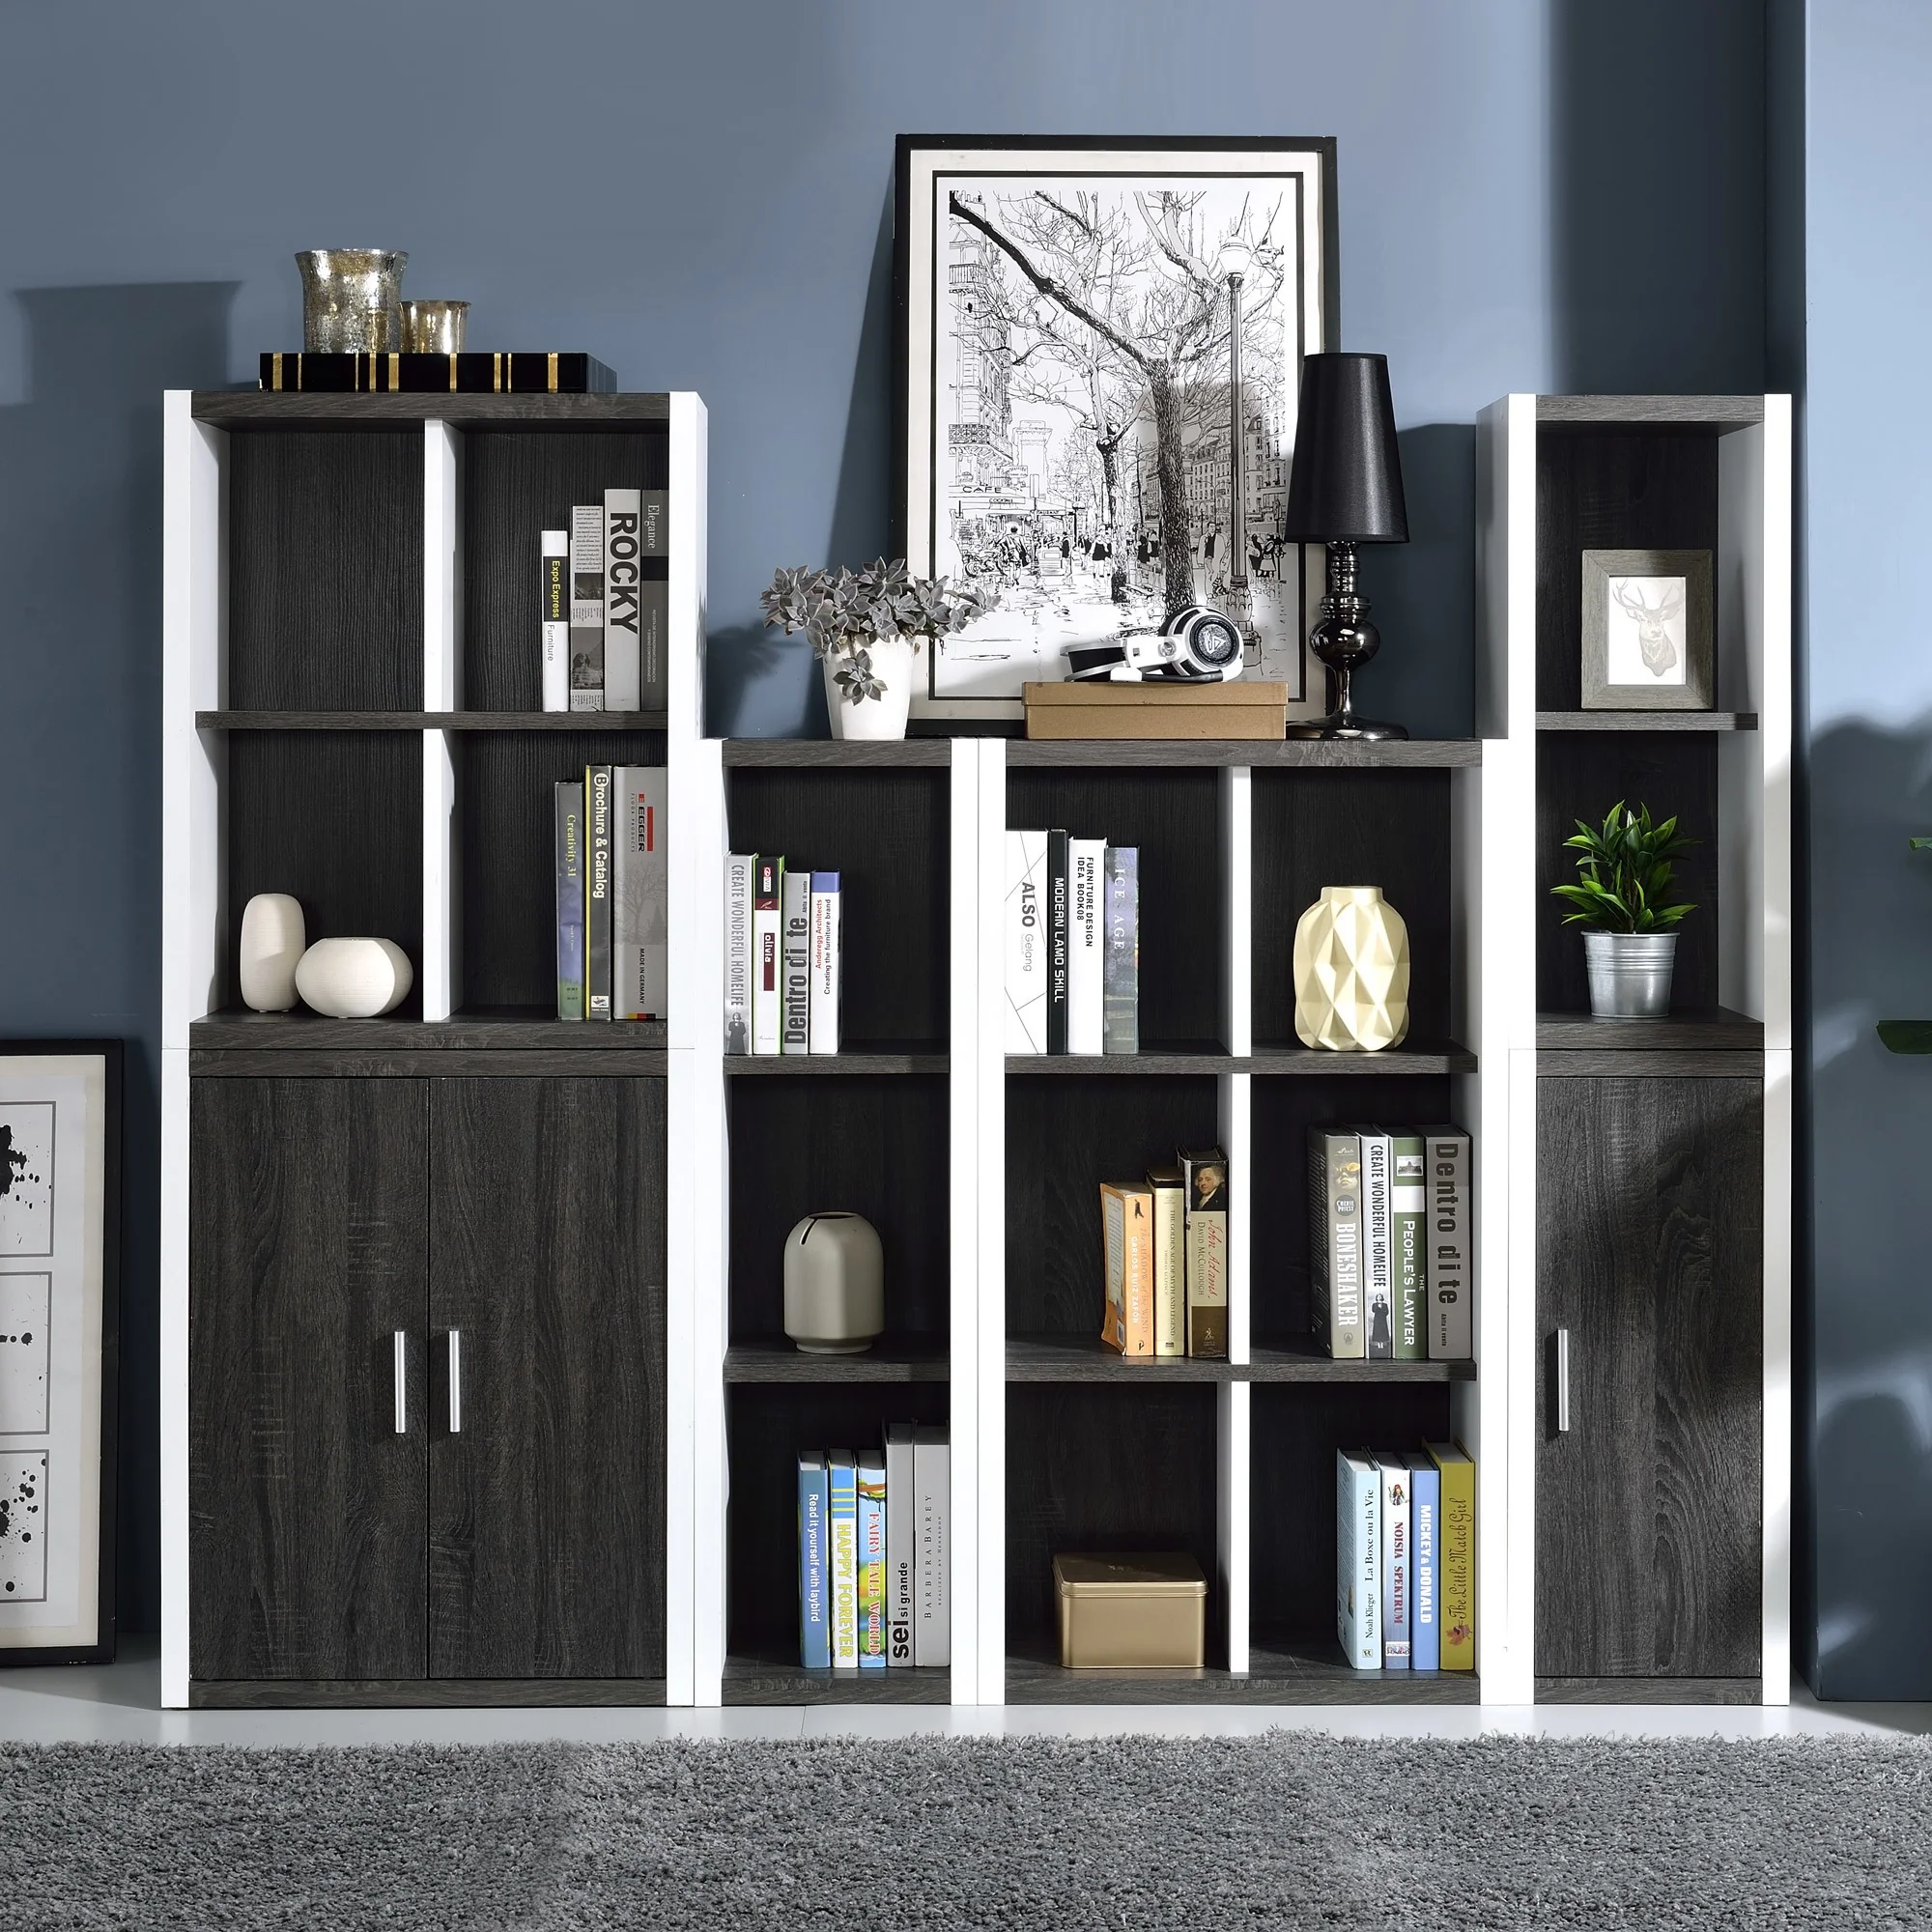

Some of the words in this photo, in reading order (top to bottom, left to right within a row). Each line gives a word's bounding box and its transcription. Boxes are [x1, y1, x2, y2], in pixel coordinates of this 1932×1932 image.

[644, 504, 660, 549] Elegance
[551, 560, 560, 582] Expo
[610, 512, 639, 635] ROCKY
[551, 583, 561, 618] Express
[547, 624, 555, 662] Furniture
[593, 773, 610, 835] Brochure
[565, 814, 577, 863] Creativity
[595, 838, 607, 847] &
[567, 866, 576, 877] 31
[592, 851, 608, 898] Catalog
[730, 865, 745, 897] CREATE
[1086, 857, 1094, 910] FURNITURE
[1114, 868, 1125, 899] ICE
[1021, 881, 1036, 927] ALSO
[1054, 877, 1065, 927] MODERN
[1076, 883, 1085, 921] BOOK08
[730, 900, 745, 957] WONDERFUL
[786, 917, 808, 938] te
[1085, 912, 1094, 948] DESIGN
[1114, 914, 1125, 950] AGE
[764, 934, 775, 963] olivia
[785, 949, 808, 969] di
[815, 935, 824, 970] Anderegg
[1023, 933, 1035, 972] Gelang
[730, 960, 745, 1006] HOMELIFE
[824, 964, 833, 995] Creating
[1054, 969, 1065, 1004] SKILL
[783, 975, 808, 1044] Dentro
[1370, 1145, 1384, 1178] CREATE
[1435, 1144, 1460, 1233] Dentro
[1371, 1180, 1386, 1238] WONDERFUL
[1197, 1221, 1206, 1243] DAVID
[1208, 1219, 1223, 1248] John
[1169, 1265, 1176, 1274] OF
[1335, 1222, 1359, 1326] BONESHAKER
[1373, 1241, 1387, 1287] HOMELIFE
[1437, 1245, 1462, 1270] di
[1437, 1280, 1461, 1304] te
[1141, 1308, 1150, 1333] WIND
[1403, 1289, 1415, 1346] LAWYER
[809, 1493, 819, 1519] Read
[809, 1520, 819, 1528] it
[1365, 1510, 1374, 1520] la
[1449, 1497, 1473, 1522] Girl
[807, 1528, 819, 1566] yourself
[868, 1512, 880, 1556] FAIRY
[1367, 1522, 1374, 1536] ou
[1394, 1521, 1404, 1559] NOISIA
[1420, 1504, 1432, 1555] MICKEY
[1449, 1523, 1467, 1564] Match
[837, 1523, 852, 1579] HAPPY
[810, 1567, 820, 1587] with
[868, 1559, 880, 1598] TALE
[897, 1561, 910, 1605] grande
[1365, 1568, 1374, 1582] La
[1449, 1564, 1467, 1598] Little
[808, 1589, 820, 1622] laybird
[897, 1606, 909, 1618] si
[1365, 1593, 1376, 1617] Klieger
[1394, 1565, 1404, 1624] SPEKTRUM
[1419, 1566, 1433, 1624] DONALD
[1448, 1599, 1467, 1620] The
[838, 1583, 853, 1658] FOREVER
[868, 1601, 881, 1655] WORLD
[1365, 1619, 1374, 1639] Noah
[887, 1620, 909, 1659] sei
